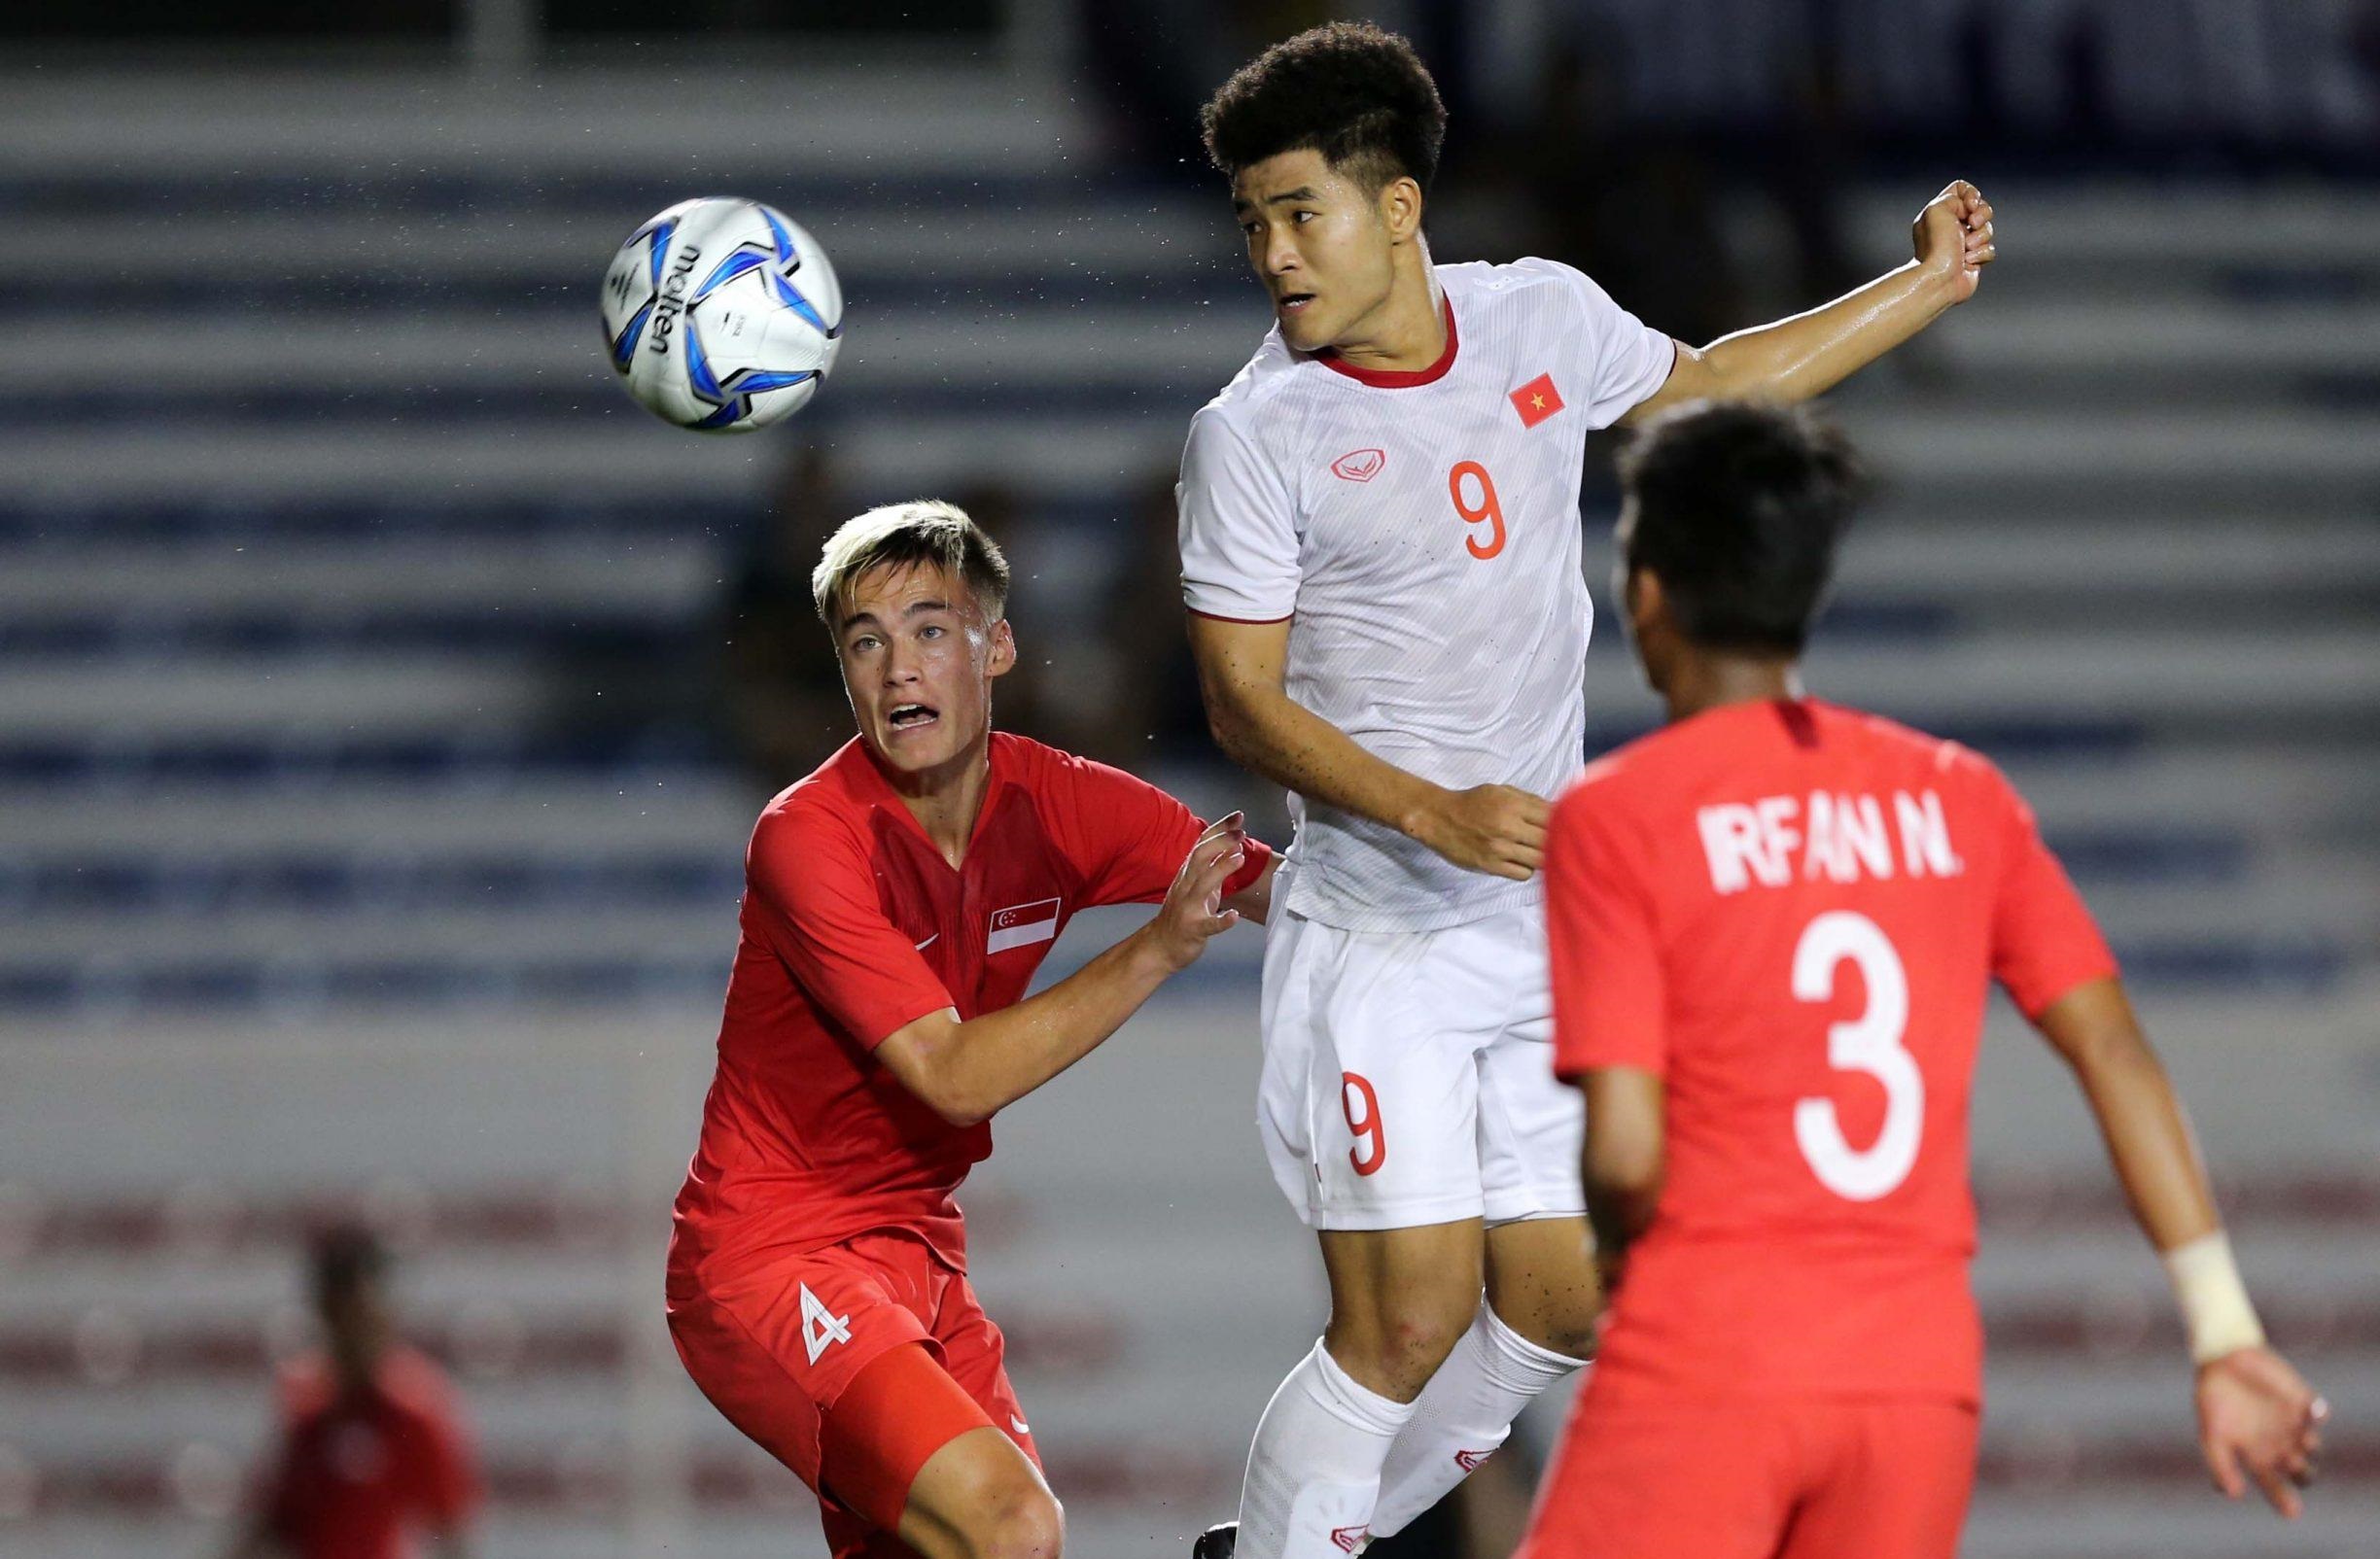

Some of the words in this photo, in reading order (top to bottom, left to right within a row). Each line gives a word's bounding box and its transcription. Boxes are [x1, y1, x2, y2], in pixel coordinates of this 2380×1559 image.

[648, 245, 701, 356] molten
[1449, 460, 1506, 560] 9
[1791, 910, 1925, 1201] 3
[1341, 1071, 1385, 1177] 9
[799, 1280, 853, 1367] 4
